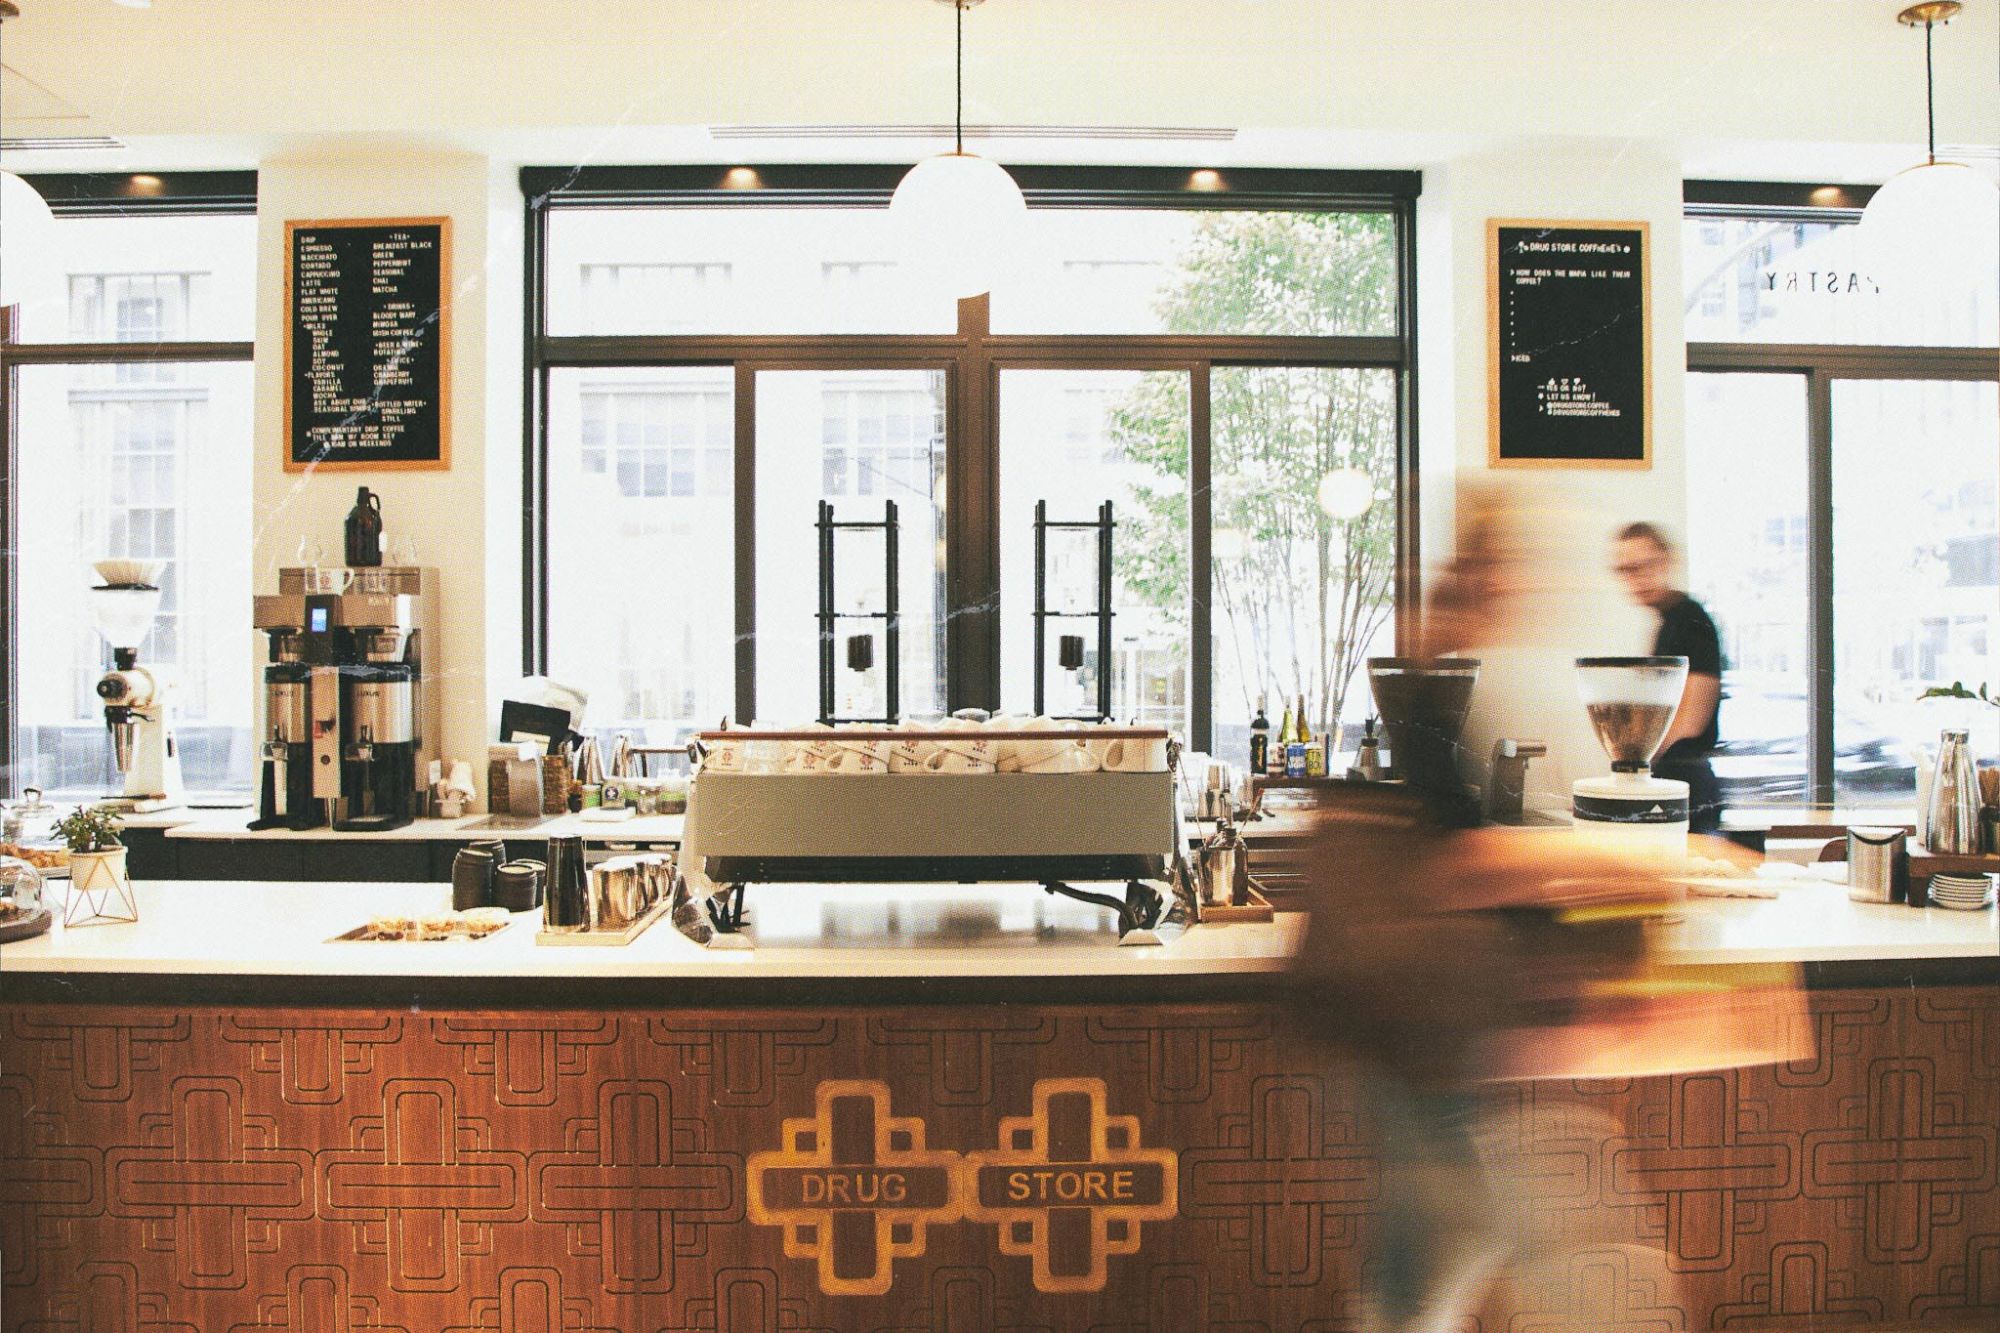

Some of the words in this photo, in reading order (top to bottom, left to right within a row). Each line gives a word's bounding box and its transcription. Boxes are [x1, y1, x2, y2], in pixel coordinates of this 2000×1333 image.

[373, 242, 408, 250] BREAKFAST
[410, 241, 432, 249] BLACK
[1529, 242, 1550, 252] DRUG
[1551, 242, 1576, 252] STORE
[301, 253, 337, 261] MACCHIATO
[373, 259, 411, 267] PEPPERMINT
[301, 270, 340, 278] CAPPUCCINO
[373, 268, 404, 276] SEASONAL
[1534, 269, 1551, 277] DOES
[1555, 269, 1566, 277] THE
[1591, 270, 1607, 278] LIKE
[1612, 270, 1630, 278] THEIR
[301, 279, 321, 287] LATTE
[373, 277, 388, 285] CHAI
[1516, 277, 1541, 285] COFFEE?
[301, 288, 316, 296] FLAT
[373, 320, 398, 328] MIMOSA
[1560, 384, 1570, 392] OR
[314, 405, 348, 413] SEASONAL
[802, 1173, 906, 1202] DRUG
[1008, 1170, 1134, 1200] STORE
